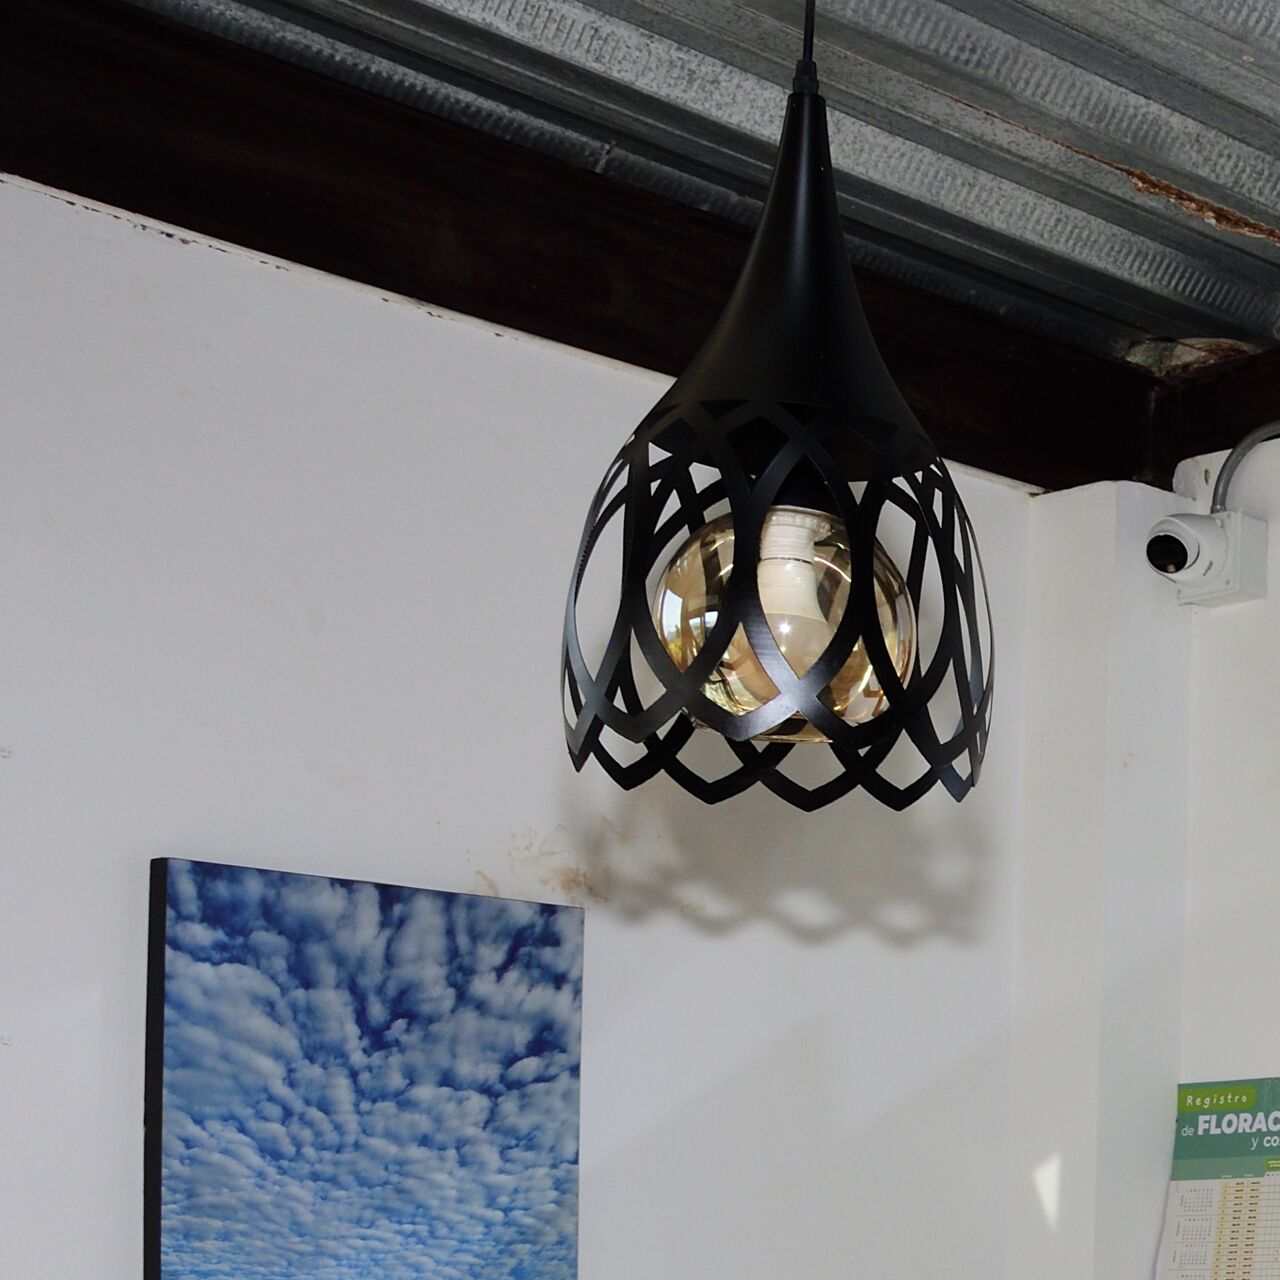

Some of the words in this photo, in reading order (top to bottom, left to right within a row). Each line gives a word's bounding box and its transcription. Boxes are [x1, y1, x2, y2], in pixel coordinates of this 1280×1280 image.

[1187, 1093, 1248, 1108] Registro
[1181, 1125, 1195, 1136] de
[1251, 1137, 1259, 1150] y
